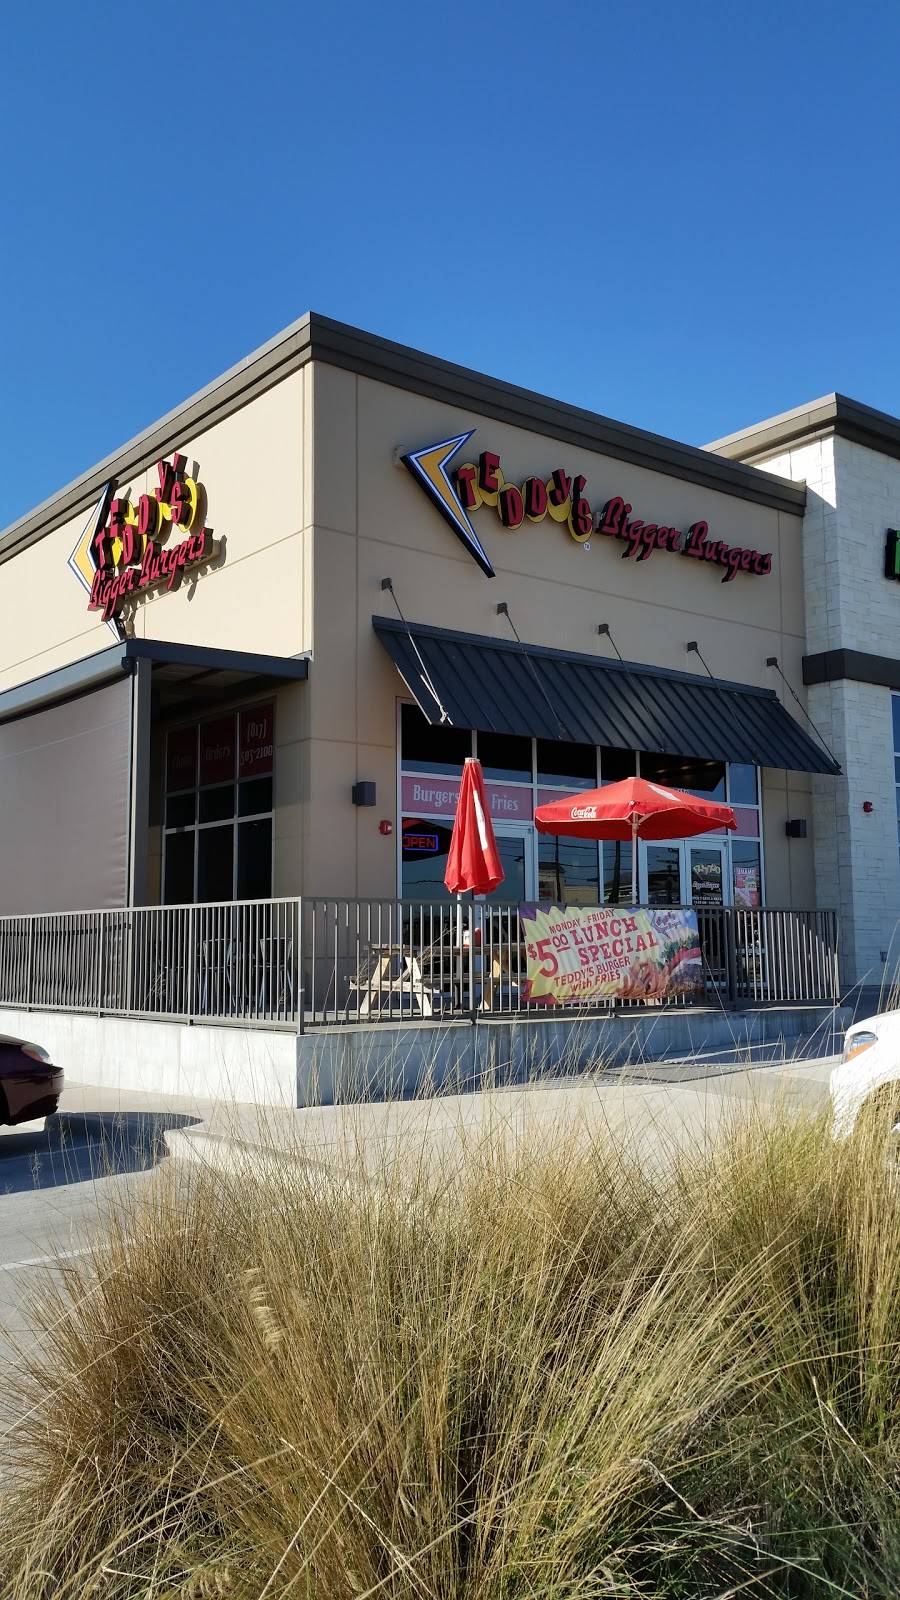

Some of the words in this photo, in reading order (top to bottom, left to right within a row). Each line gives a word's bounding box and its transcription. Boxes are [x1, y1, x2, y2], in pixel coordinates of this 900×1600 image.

[456, 451, 592, 538] TEDDY'S
[597, 496, 682, 562] Bigger
[683, 520, 772, 584] Burgers
[87, 568, 135, 622] Bigger
[138, 526, 210, 591] Burgers
[413, 784, 460, 808] Burgers
[491, 794, 519, 811] Fries
[402, 836, 436, 850] OPEN
[548, 919, 581, 934] MONDAY
[587, 908, 616, 923] FRIDAY
[569, 916, 639, 946] LUNCH
[577, 931, 660, 967] SPECIAL
[553, 966, 595, 988] TEDDY'S
[597, 956, 631, 976] BURGER
[570, 979, 592, 993] with
[594, 969, 621, 986] FRIES
